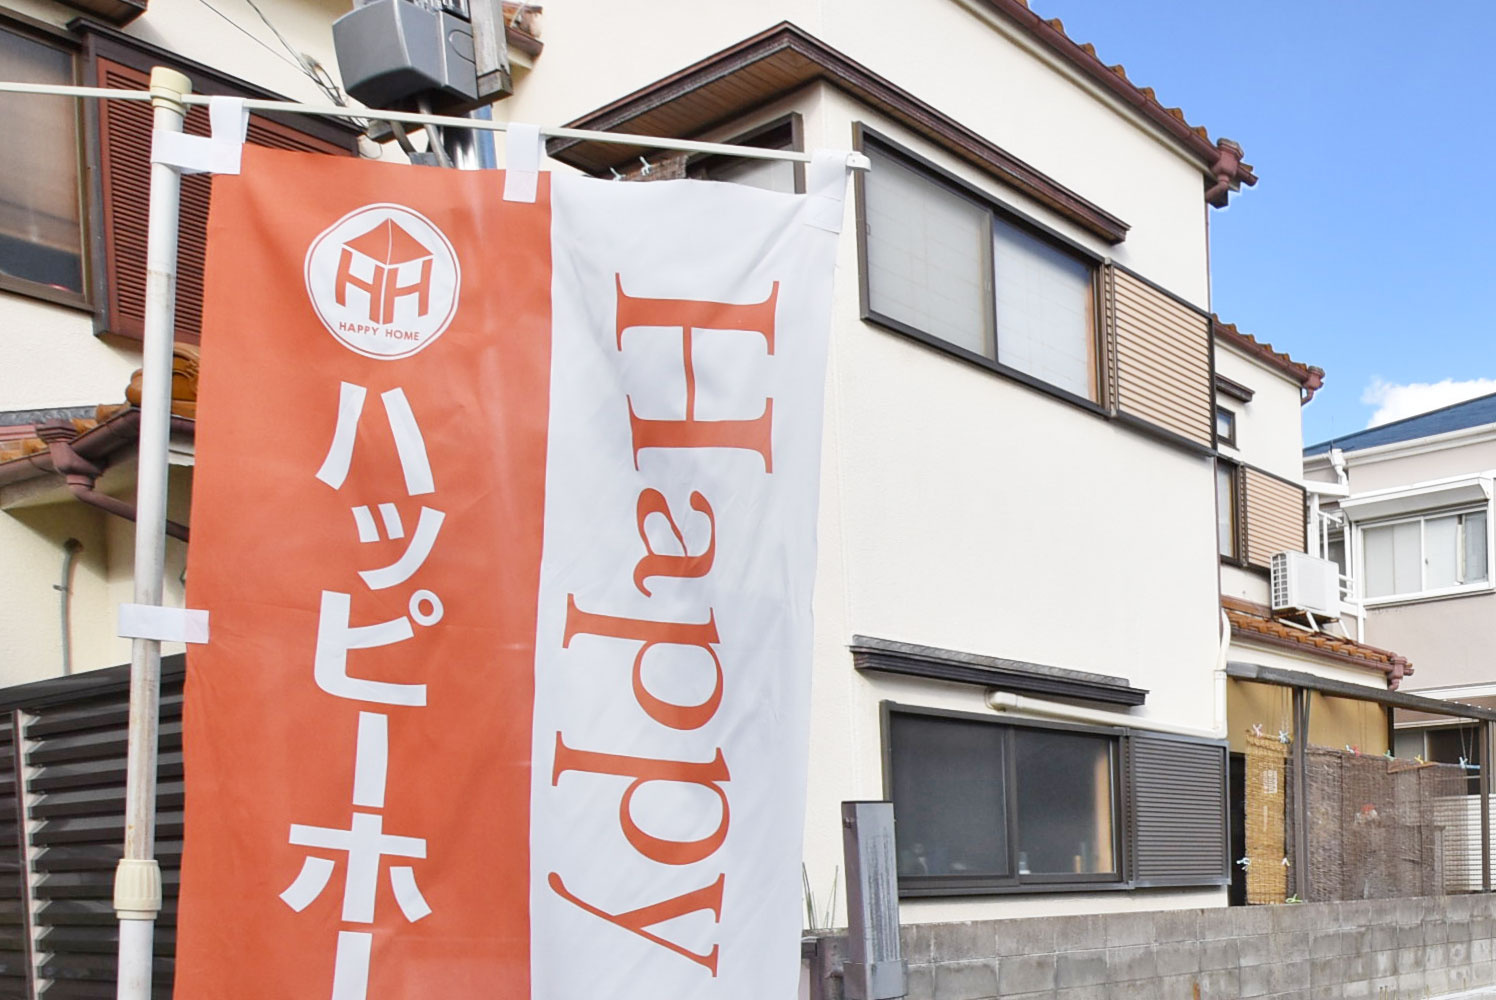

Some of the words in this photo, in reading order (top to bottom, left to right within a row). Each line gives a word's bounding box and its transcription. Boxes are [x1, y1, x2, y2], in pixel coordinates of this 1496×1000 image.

[339, 321, 379, 336] HAPPY
[385, 328, 420, 341] HOME
[547, 271, 779, 978] Happy
